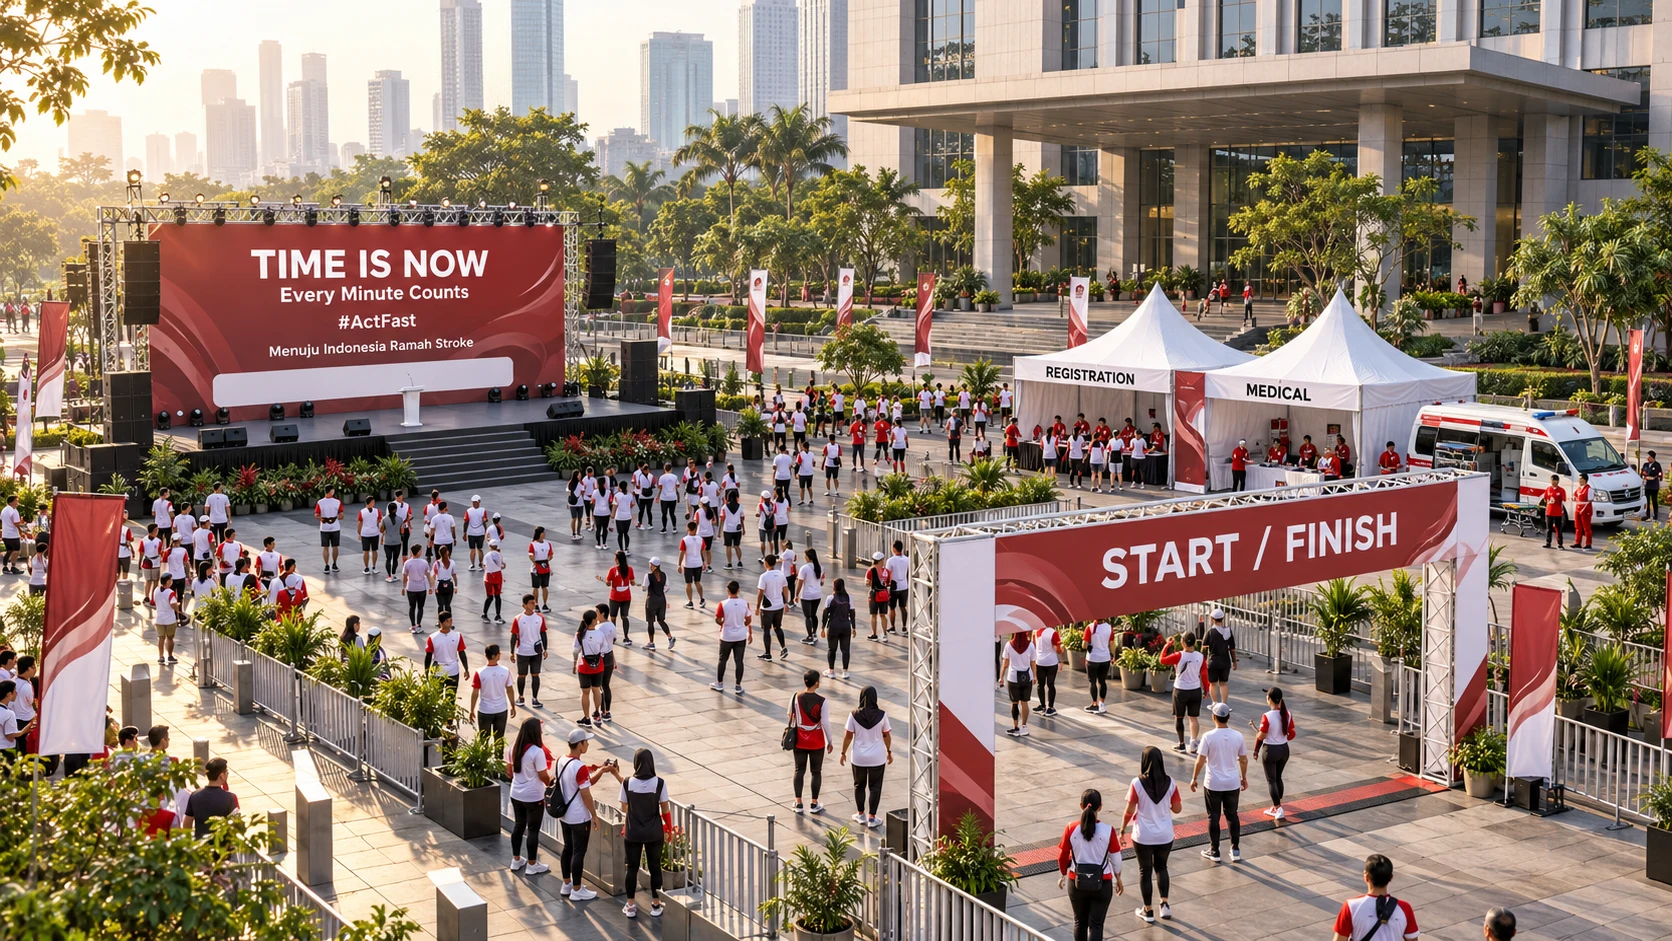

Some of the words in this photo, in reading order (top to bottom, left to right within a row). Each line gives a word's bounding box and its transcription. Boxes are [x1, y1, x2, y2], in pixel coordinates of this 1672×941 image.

[250, 249, 346, 280] TIME
[359, 248, 392, 279] IS
[403, 248, 489, 278] NOW
[280, 287, 336, 306] Every
[341, 285, 404, 302] Minute
[409, 284, 469, 300] Counts
[338, 313, 416, 330] #ActFast
[269, 343, 320, 359] Menuju
[323, 340, 386, 355] Indonesia
[390, 338, 432, 351] Ramah
[435, 336, 474, 349] Stroke
[1046, 365, 1135, 386] REGISTRATION
[1246, 383, 1312, 402] MEDICAL
[1101, 532, 1240, 590] START
[1252, 525, 1273, 571] /
[1286, 511, 1398, 563] FINISH
